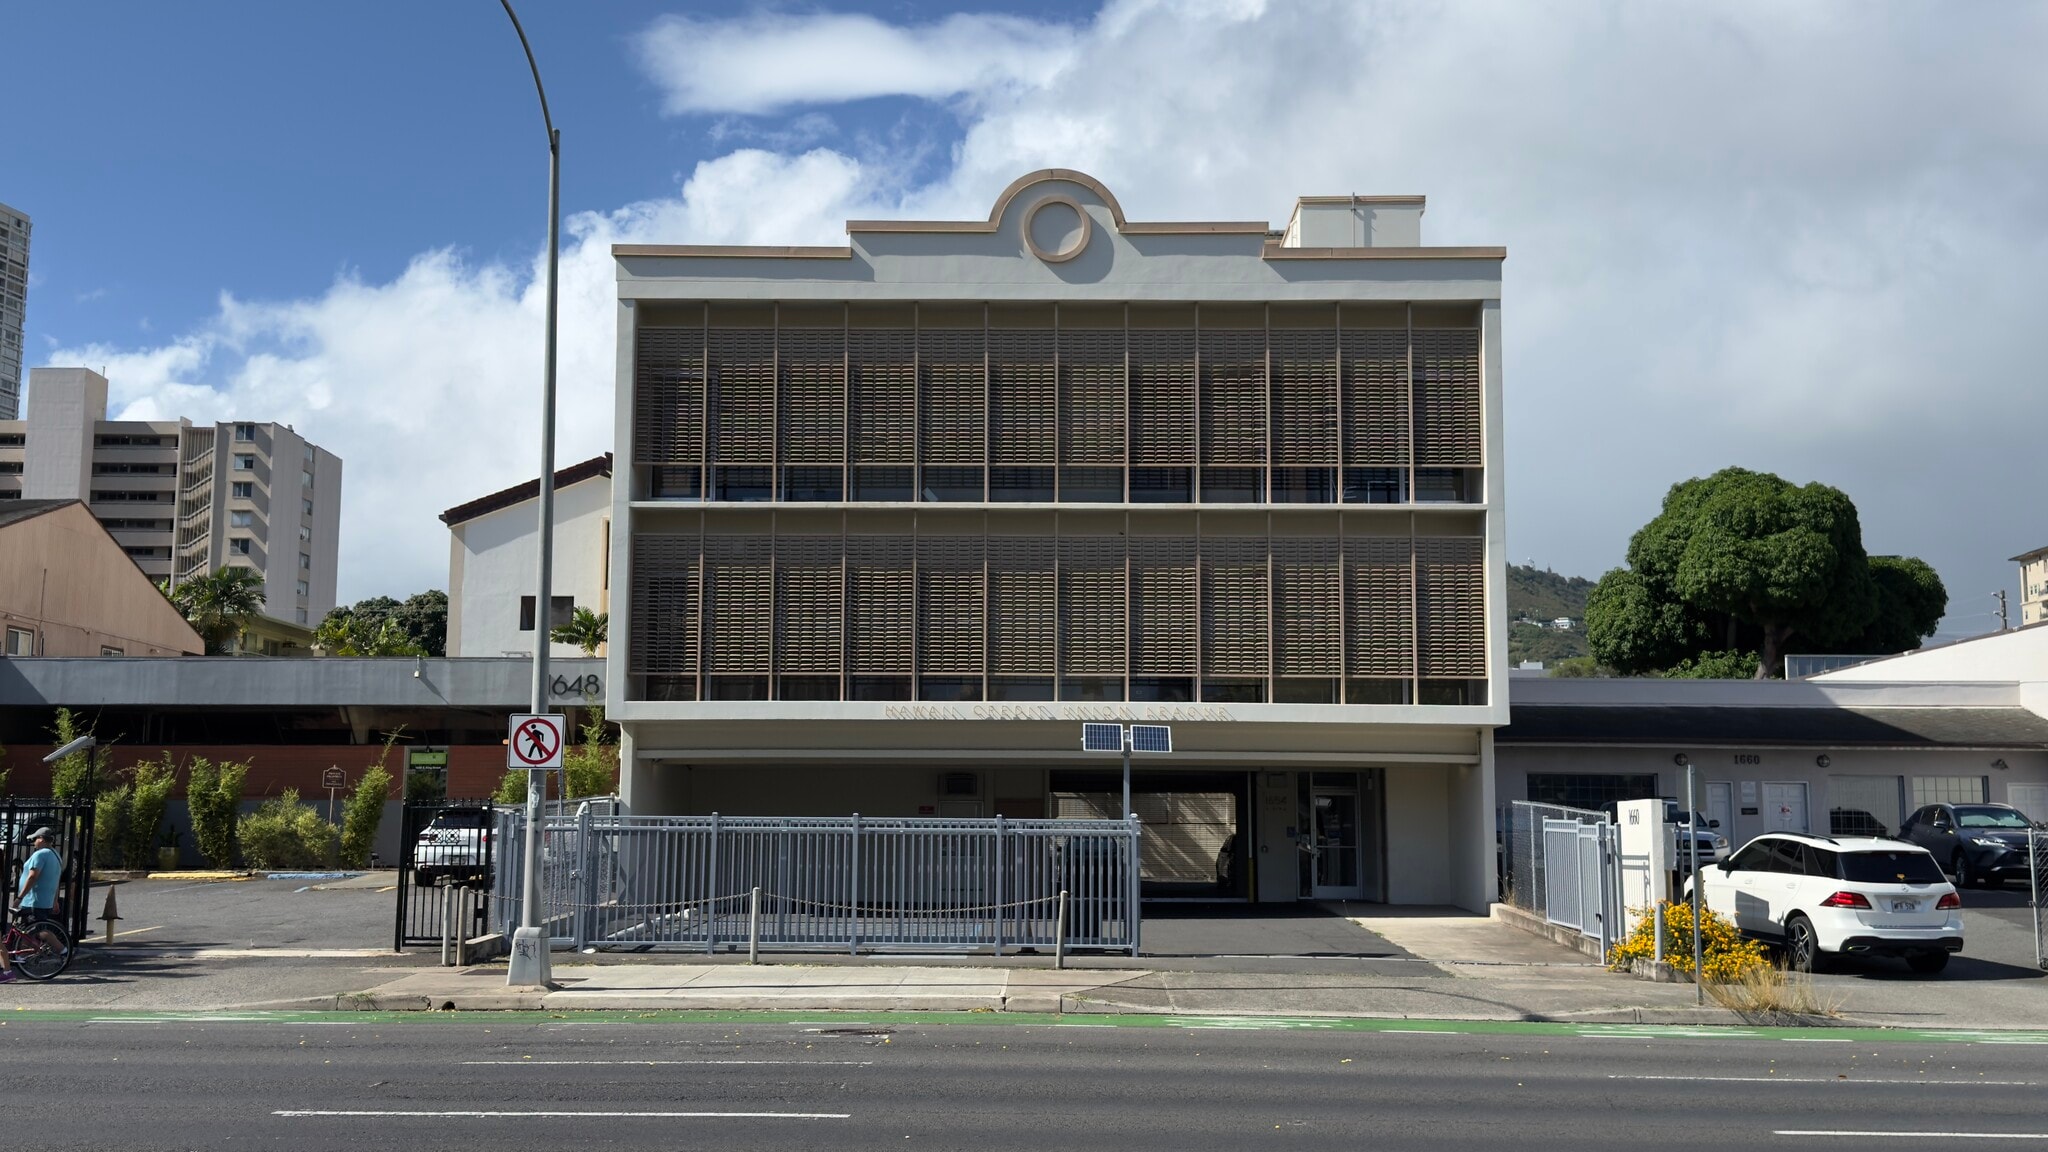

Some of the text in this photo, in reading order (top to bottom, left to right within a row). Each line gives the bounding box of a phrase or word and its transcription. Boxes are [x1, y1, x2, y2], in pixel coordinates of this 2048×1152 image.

[549, 674, 600, 696] 1648
[885, 704, 1224, 717] HAWAII CREDIT UNION LEAGUE
[1734, 755, 1760, 765] 1660
[1628, 809, 1640, 825] 1660
